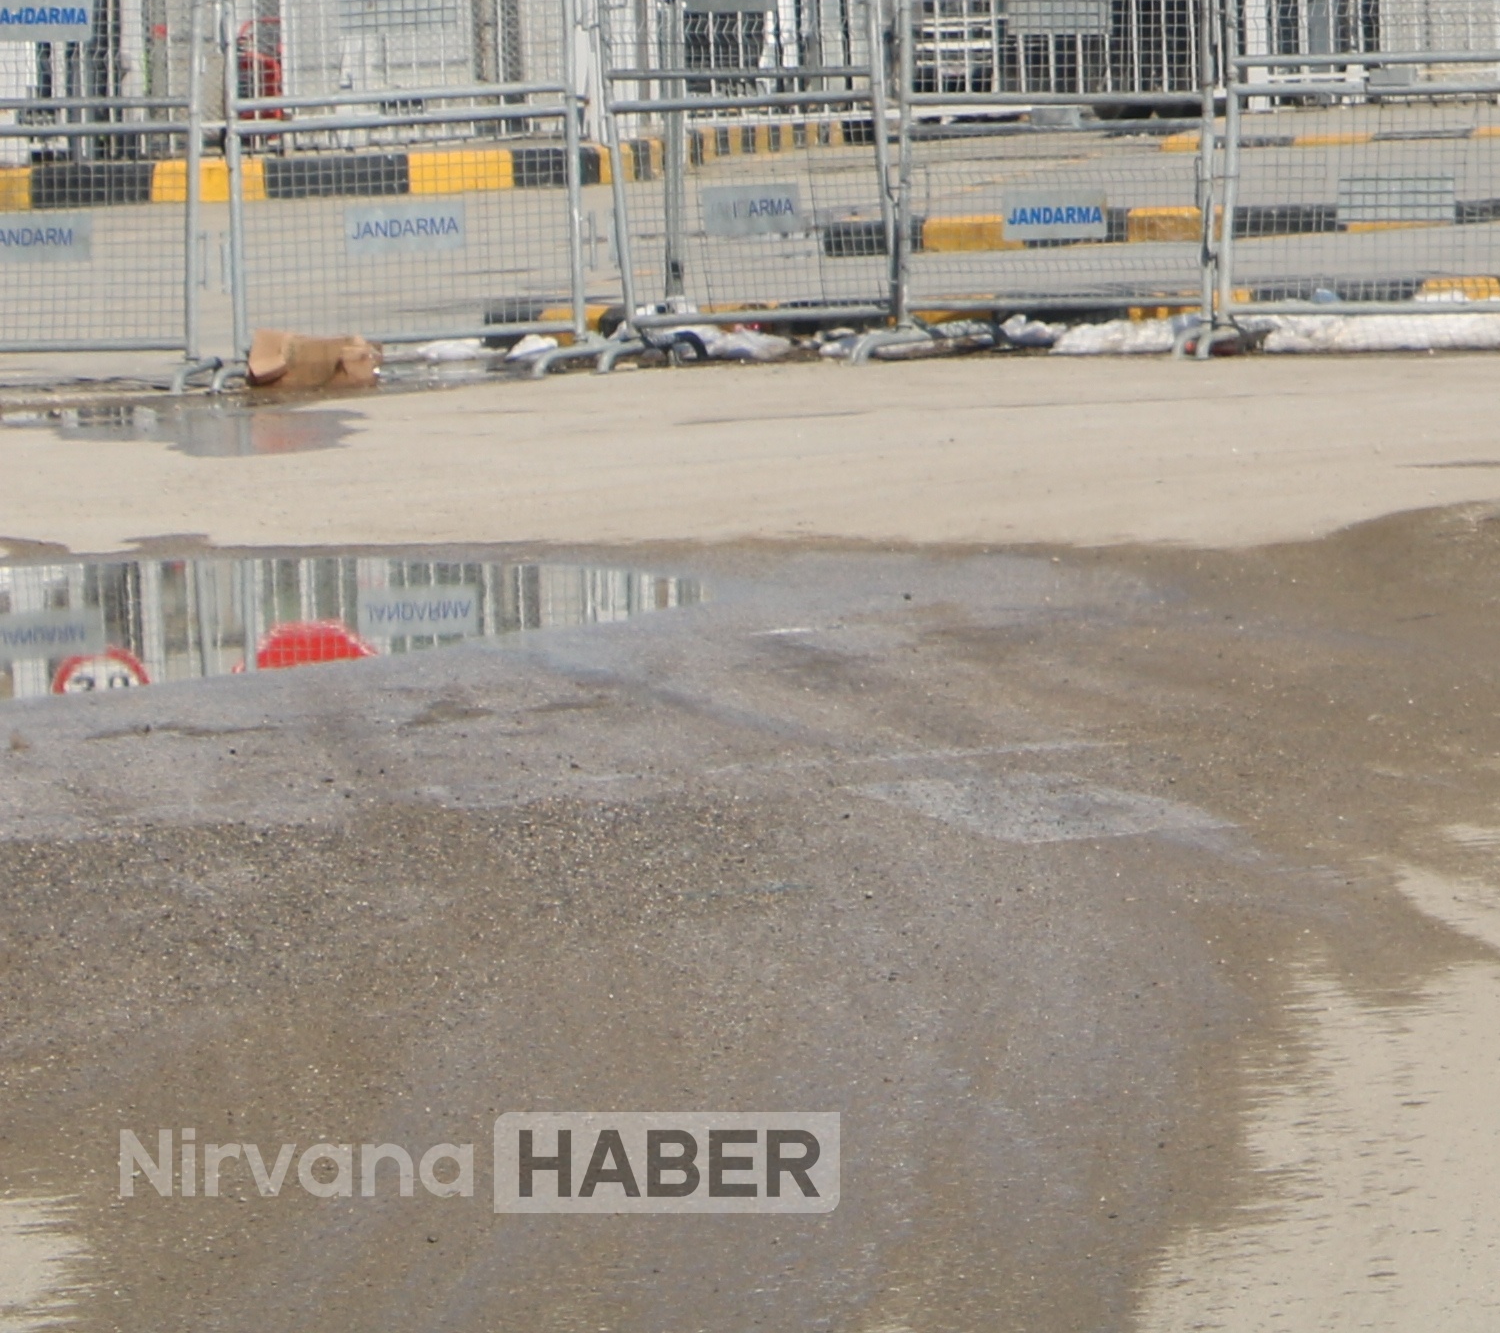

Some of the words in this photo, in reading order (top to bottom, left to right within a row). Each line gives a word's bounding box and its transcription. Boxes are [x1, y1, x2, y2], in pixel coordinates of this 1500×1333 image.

[0, 7, 88, 26] ANDARMA
[1007, 206, 1103, 226] JANDARMA
[351, 215, 460, 240] JANDARMA
